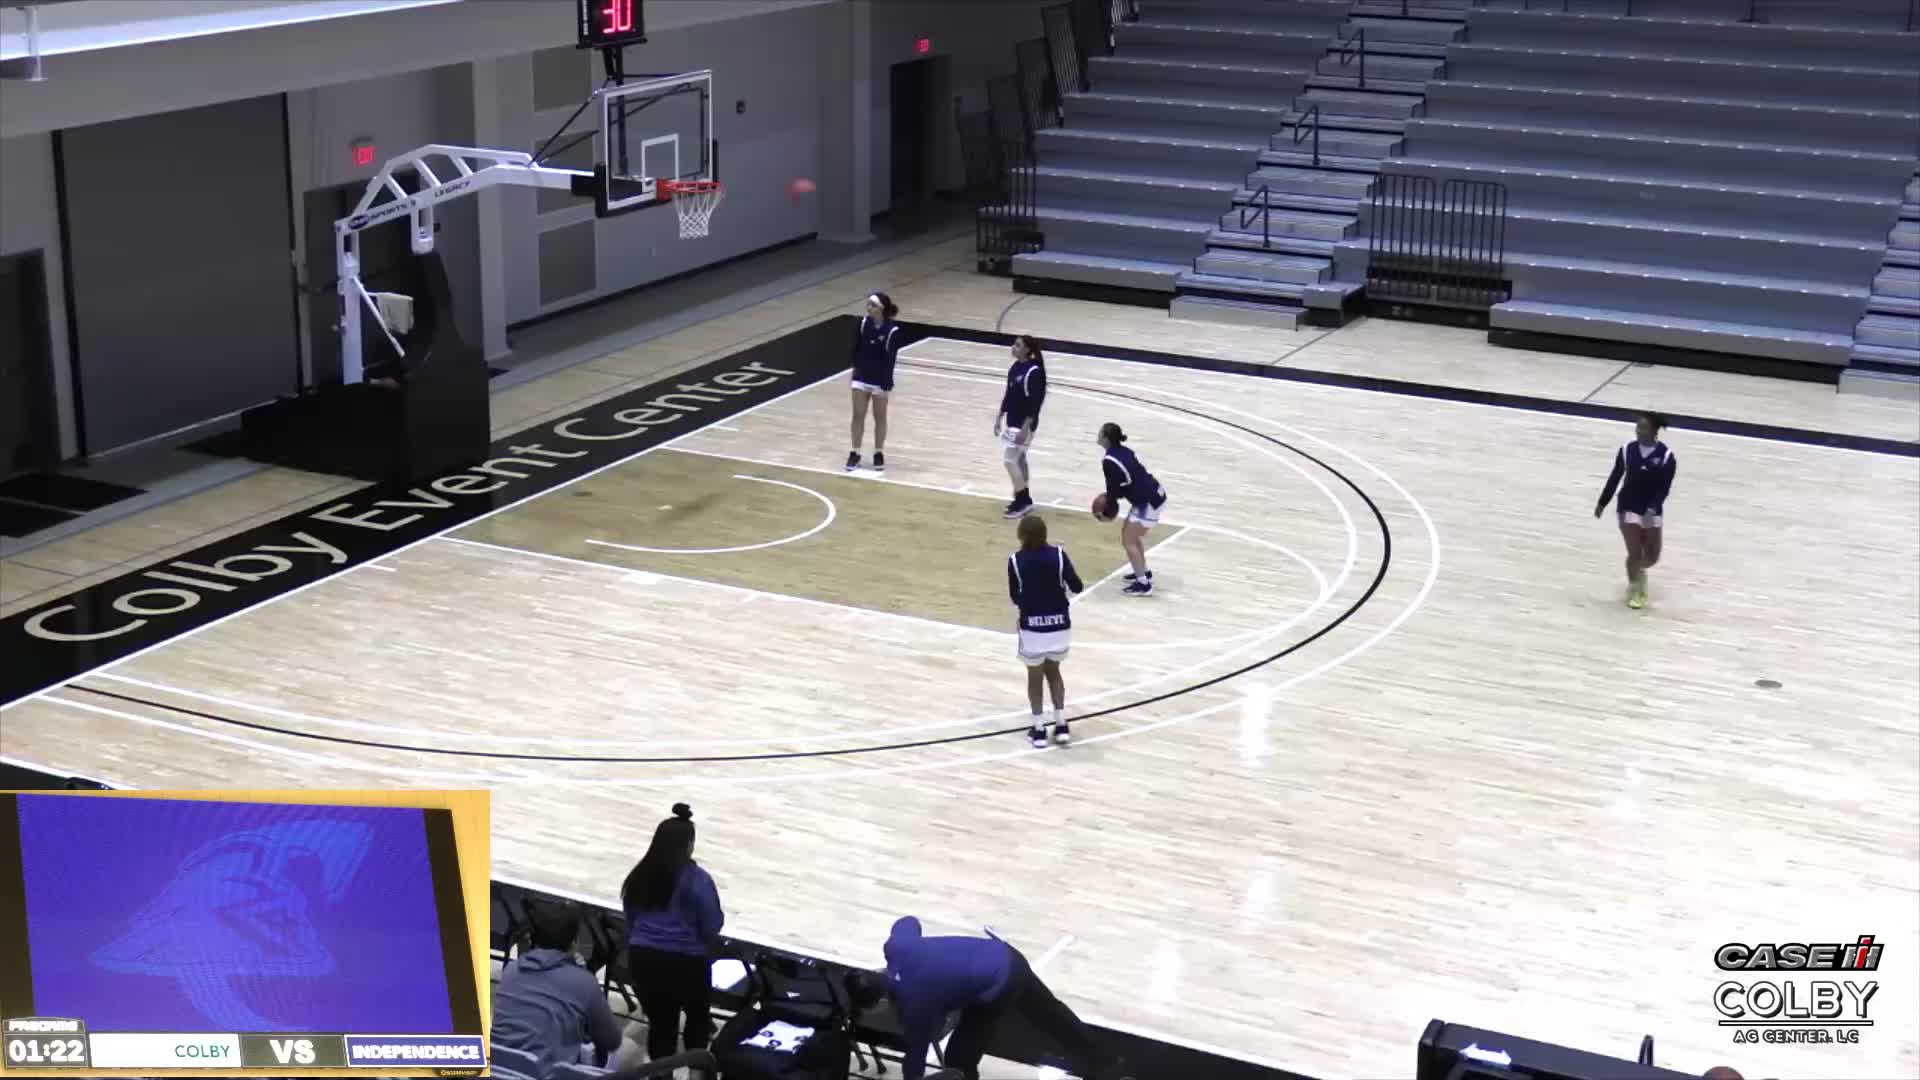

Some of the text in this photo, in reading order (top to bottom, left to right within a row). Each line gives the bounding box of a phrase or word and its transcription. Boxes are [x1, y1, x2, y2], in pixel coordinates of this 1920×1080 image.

[602, 0, 632, 34] 30
[23, 359, 798, 642] Colby Event Center
[1027, 614, 1065, 627] BELIEVE
